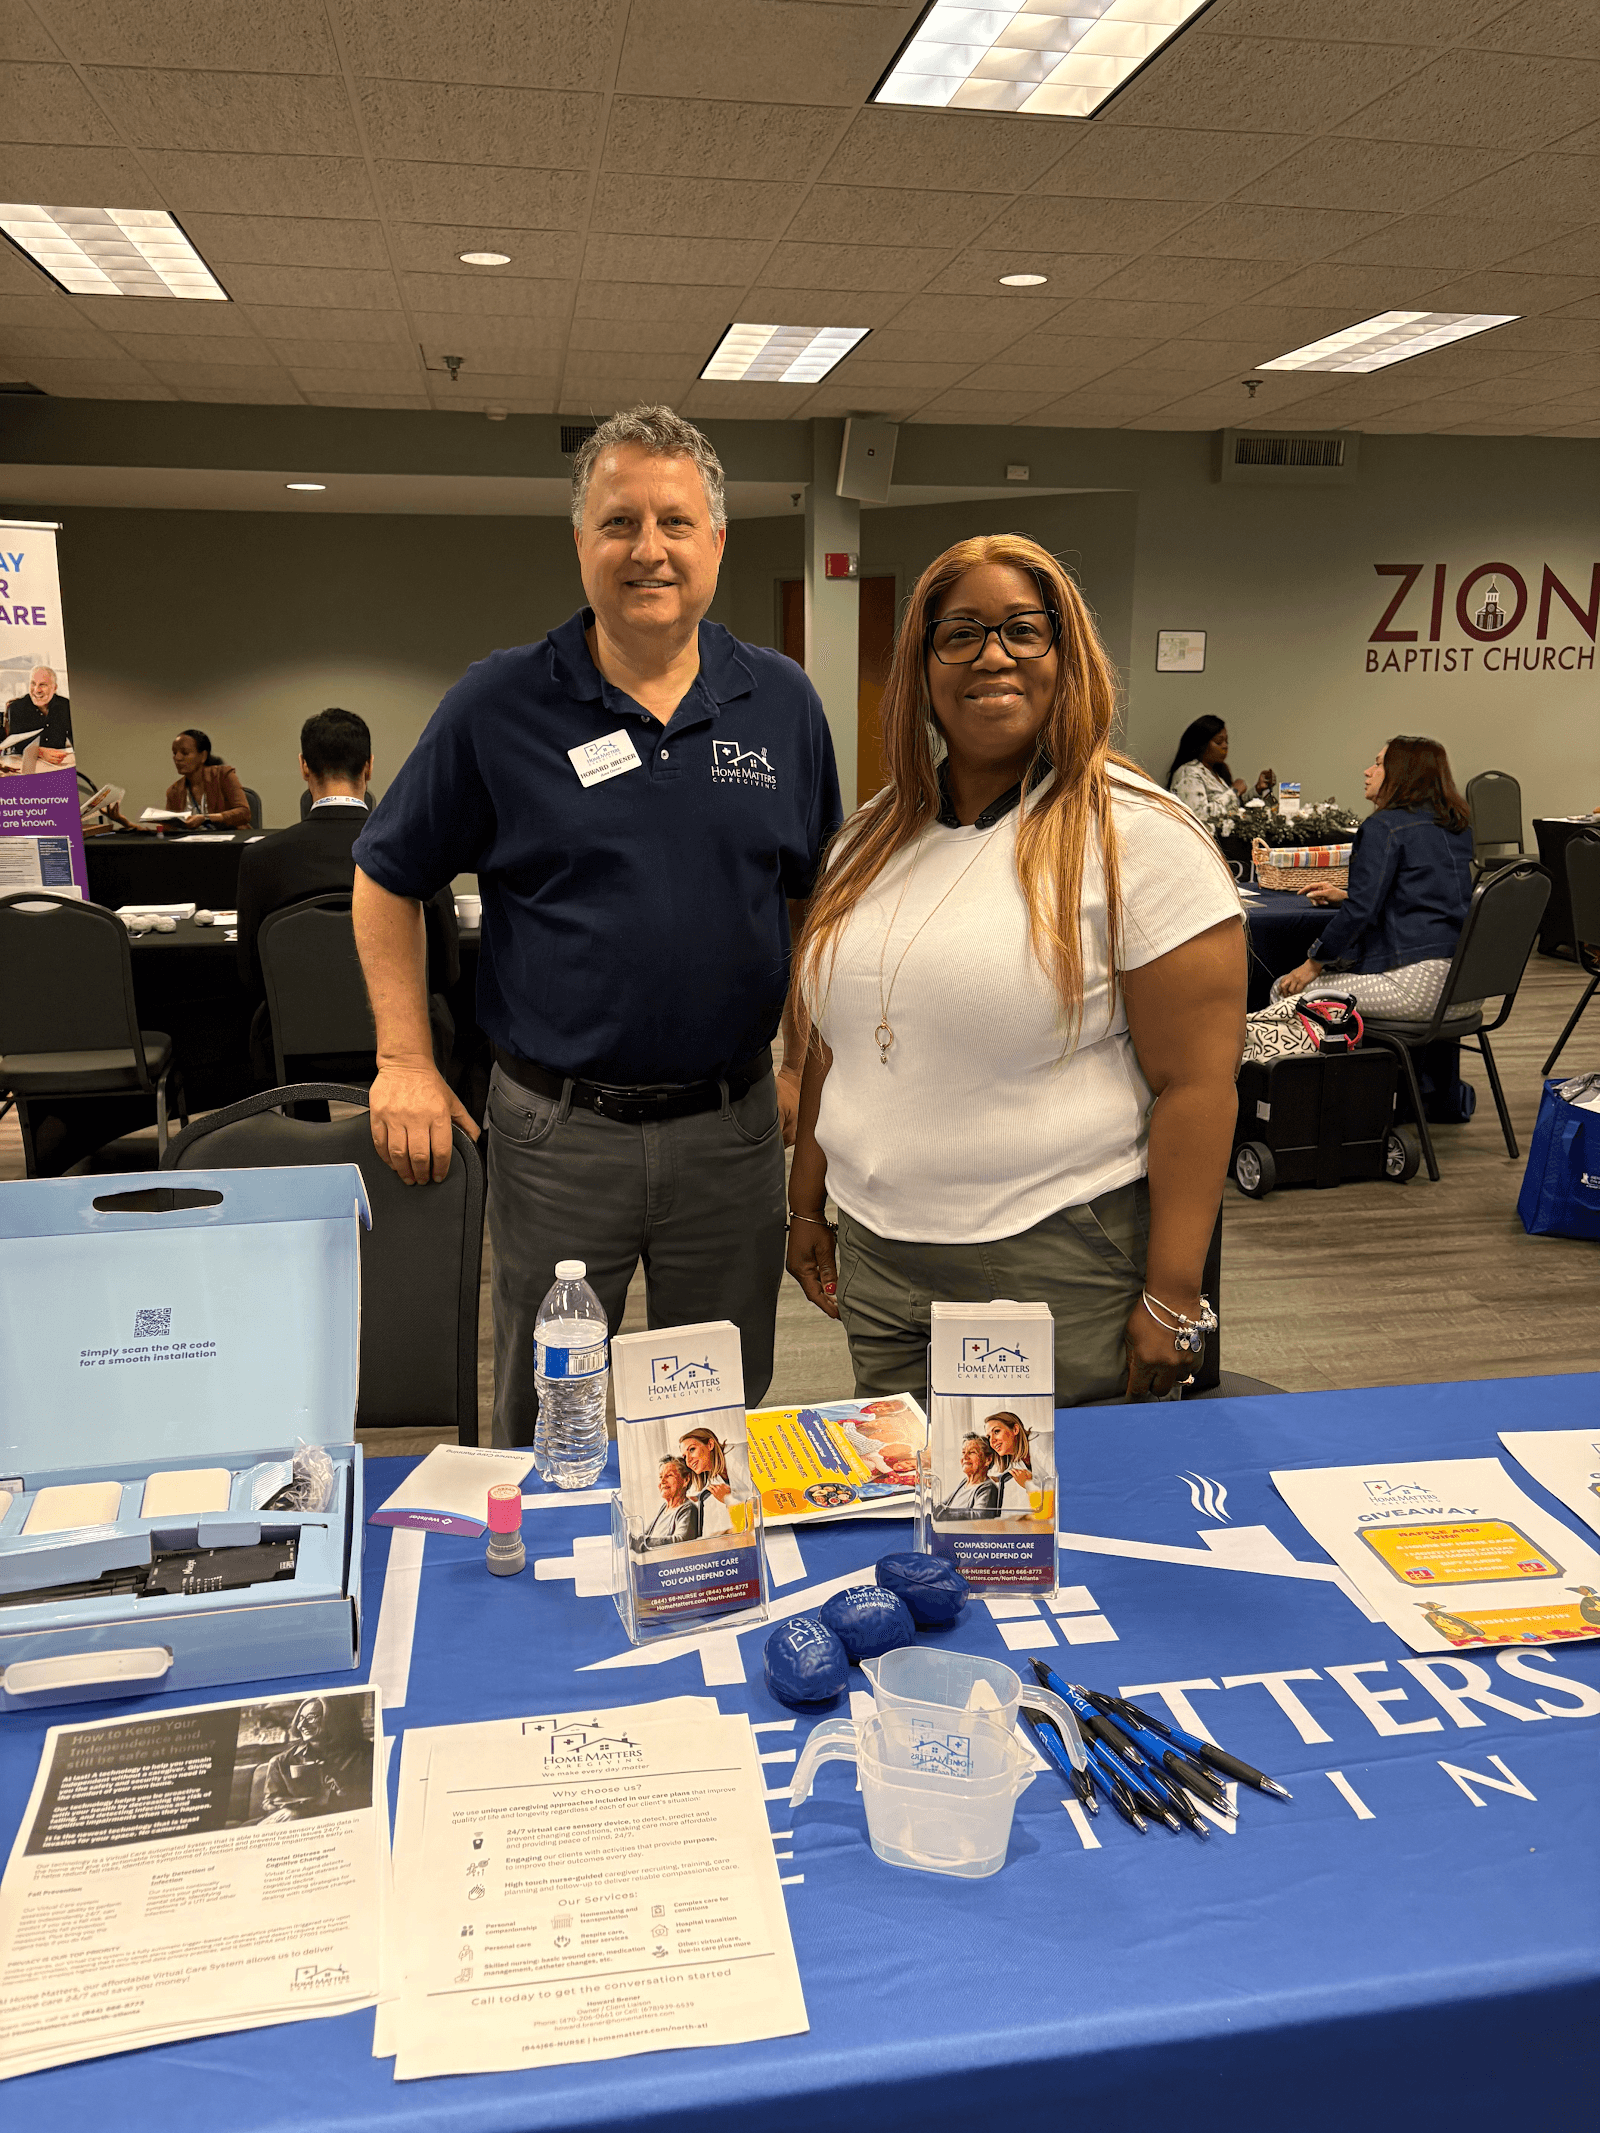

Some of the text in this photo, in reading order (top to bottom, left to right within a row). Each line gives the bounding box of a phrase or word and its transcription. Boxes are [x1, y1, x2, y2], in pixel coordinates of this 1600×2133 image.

[1368, 562, 1600, 643] ZION
[1366, 646, 1595, 672] BAPTIST CHURCH
[581, 753, 636, 779] HOWARD BRENER
[713, 777, 776, 790] CAREGIVING
[26, 808, 47, 818] your
[21, 819, 57, 827] known.
[80, 1348, 119, 1357] Simply
[122, 1346, 148, 1354] scan
[108, 1355, 150, 1364] smooth
[154, 1350, 217, 1361] installation
[649, 1387, 720, 1401] CAREGIVING
[1357, 1507, 1479, 1522] GIVEAWAY
[658, 1557, 739, 1577] COMPASSIONATE CARE
[661, 1579, 677, 1587] YOU
[678, 1576, 694, 1584] CAN
[696, 1571, 724, 1580] DEPEND
[668, 1592, 697, 1603] 66-NURSE
[723, 1583, 749, 1592] 666-8773
[656, 1591, 746, 1611] HomeMatters.com/North-Atlanta
[72, 1720, 196, 1745] How to Keep Your
[544, 1757, 643, 1770] CAREGIVING
[606, 1766, 620, 1774] day
[552, 1783, 642, 1798] Why choose us?
[481, 1807, 508, 1815] unique
[509, 1803, 548, 1813] caregiving
[550, 1799, 594, 1810] approaches
[596, 1795, 628, 1804] included
[670, 1790, 690, 1800] plans
[708, 1787, 736, 1796] improve
[507, 1827, 526, 1836] 24/7
[527, 1825, 552, 1834] virtual
[572, 1822, 602, 1830] sensory
[505, 1880, 523, 1889] High
[525, 1877, 548, 1886] touch
[558, 1892, 638, 1907] Our Services:
[471, 1968, 731, 2006] Call today to get the conversation started
[587, 1996, 615, 2006] Howard
